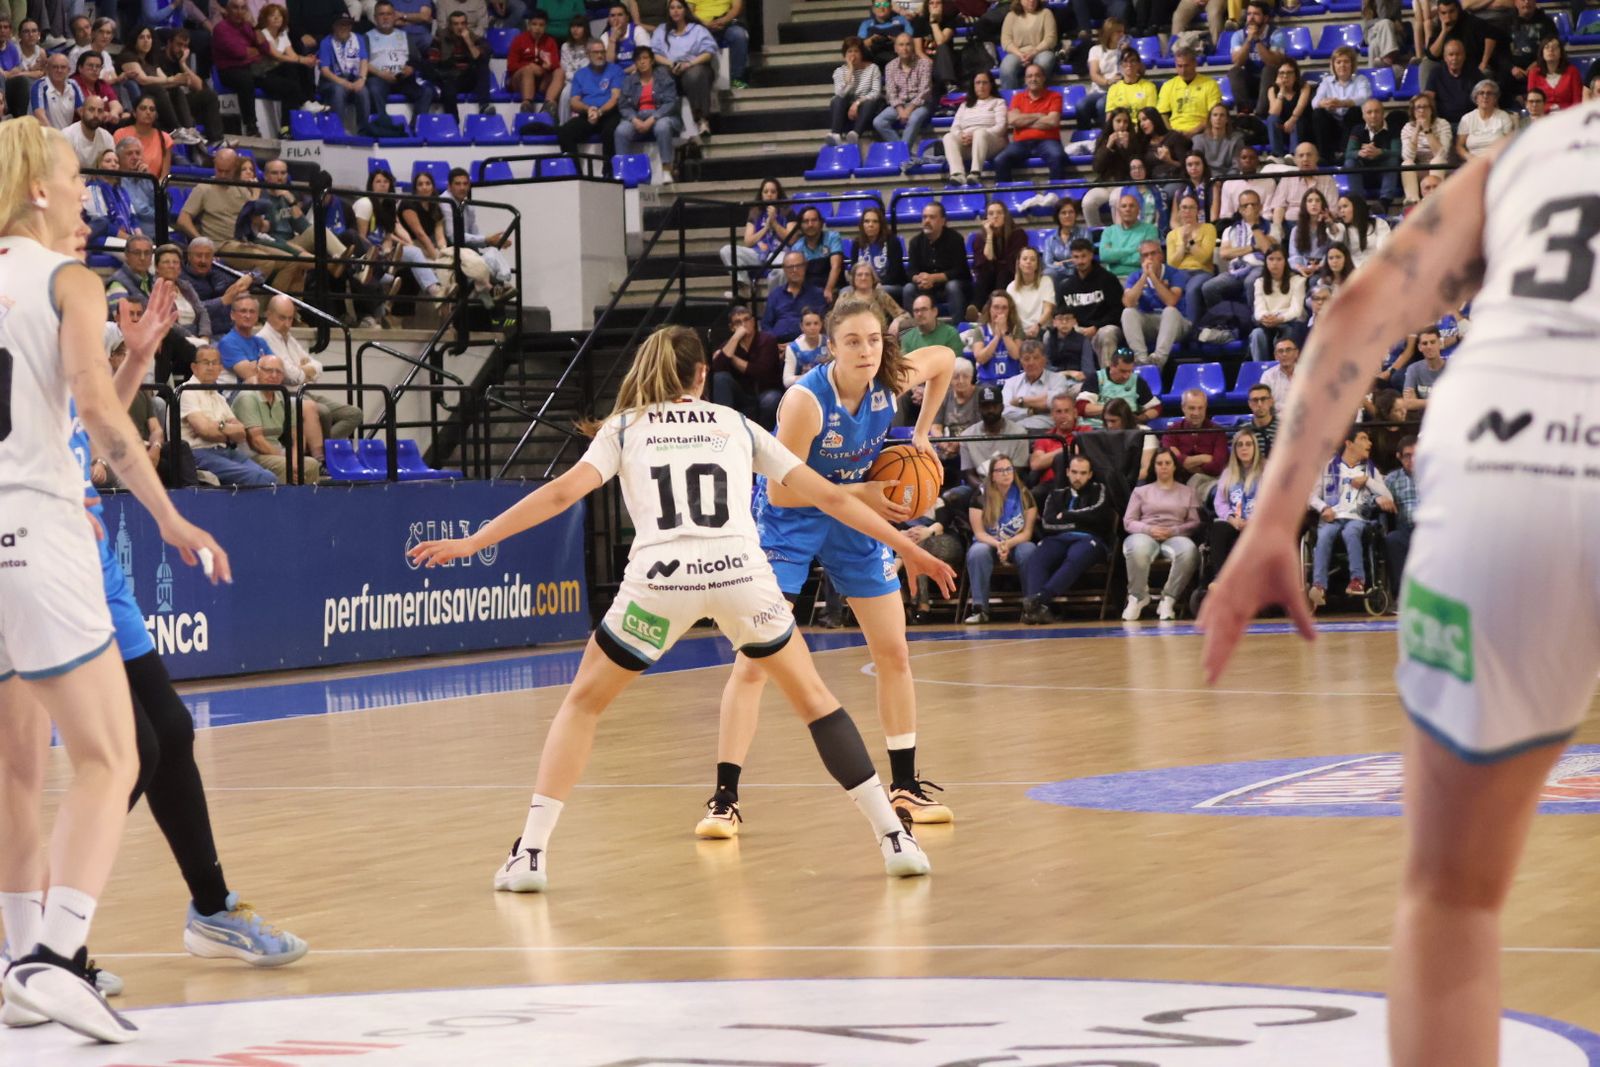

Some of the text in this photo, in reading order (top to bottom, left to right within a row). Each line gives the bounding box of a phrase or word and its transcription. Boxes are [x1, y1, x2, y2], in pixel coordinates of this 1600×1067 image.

[287, 147, 321, 157] FILA 4
[648, 411, 717, 424] MATAIX
[646, 435, 711, 446] Alcantarilla
[650, 463, 729, 530] 10
[647, 575, 754, 592] Conservando Momentos
[324, 573, 580, 647] perfumeriasavenida.com
[626, 614, 661, 641] CRC
